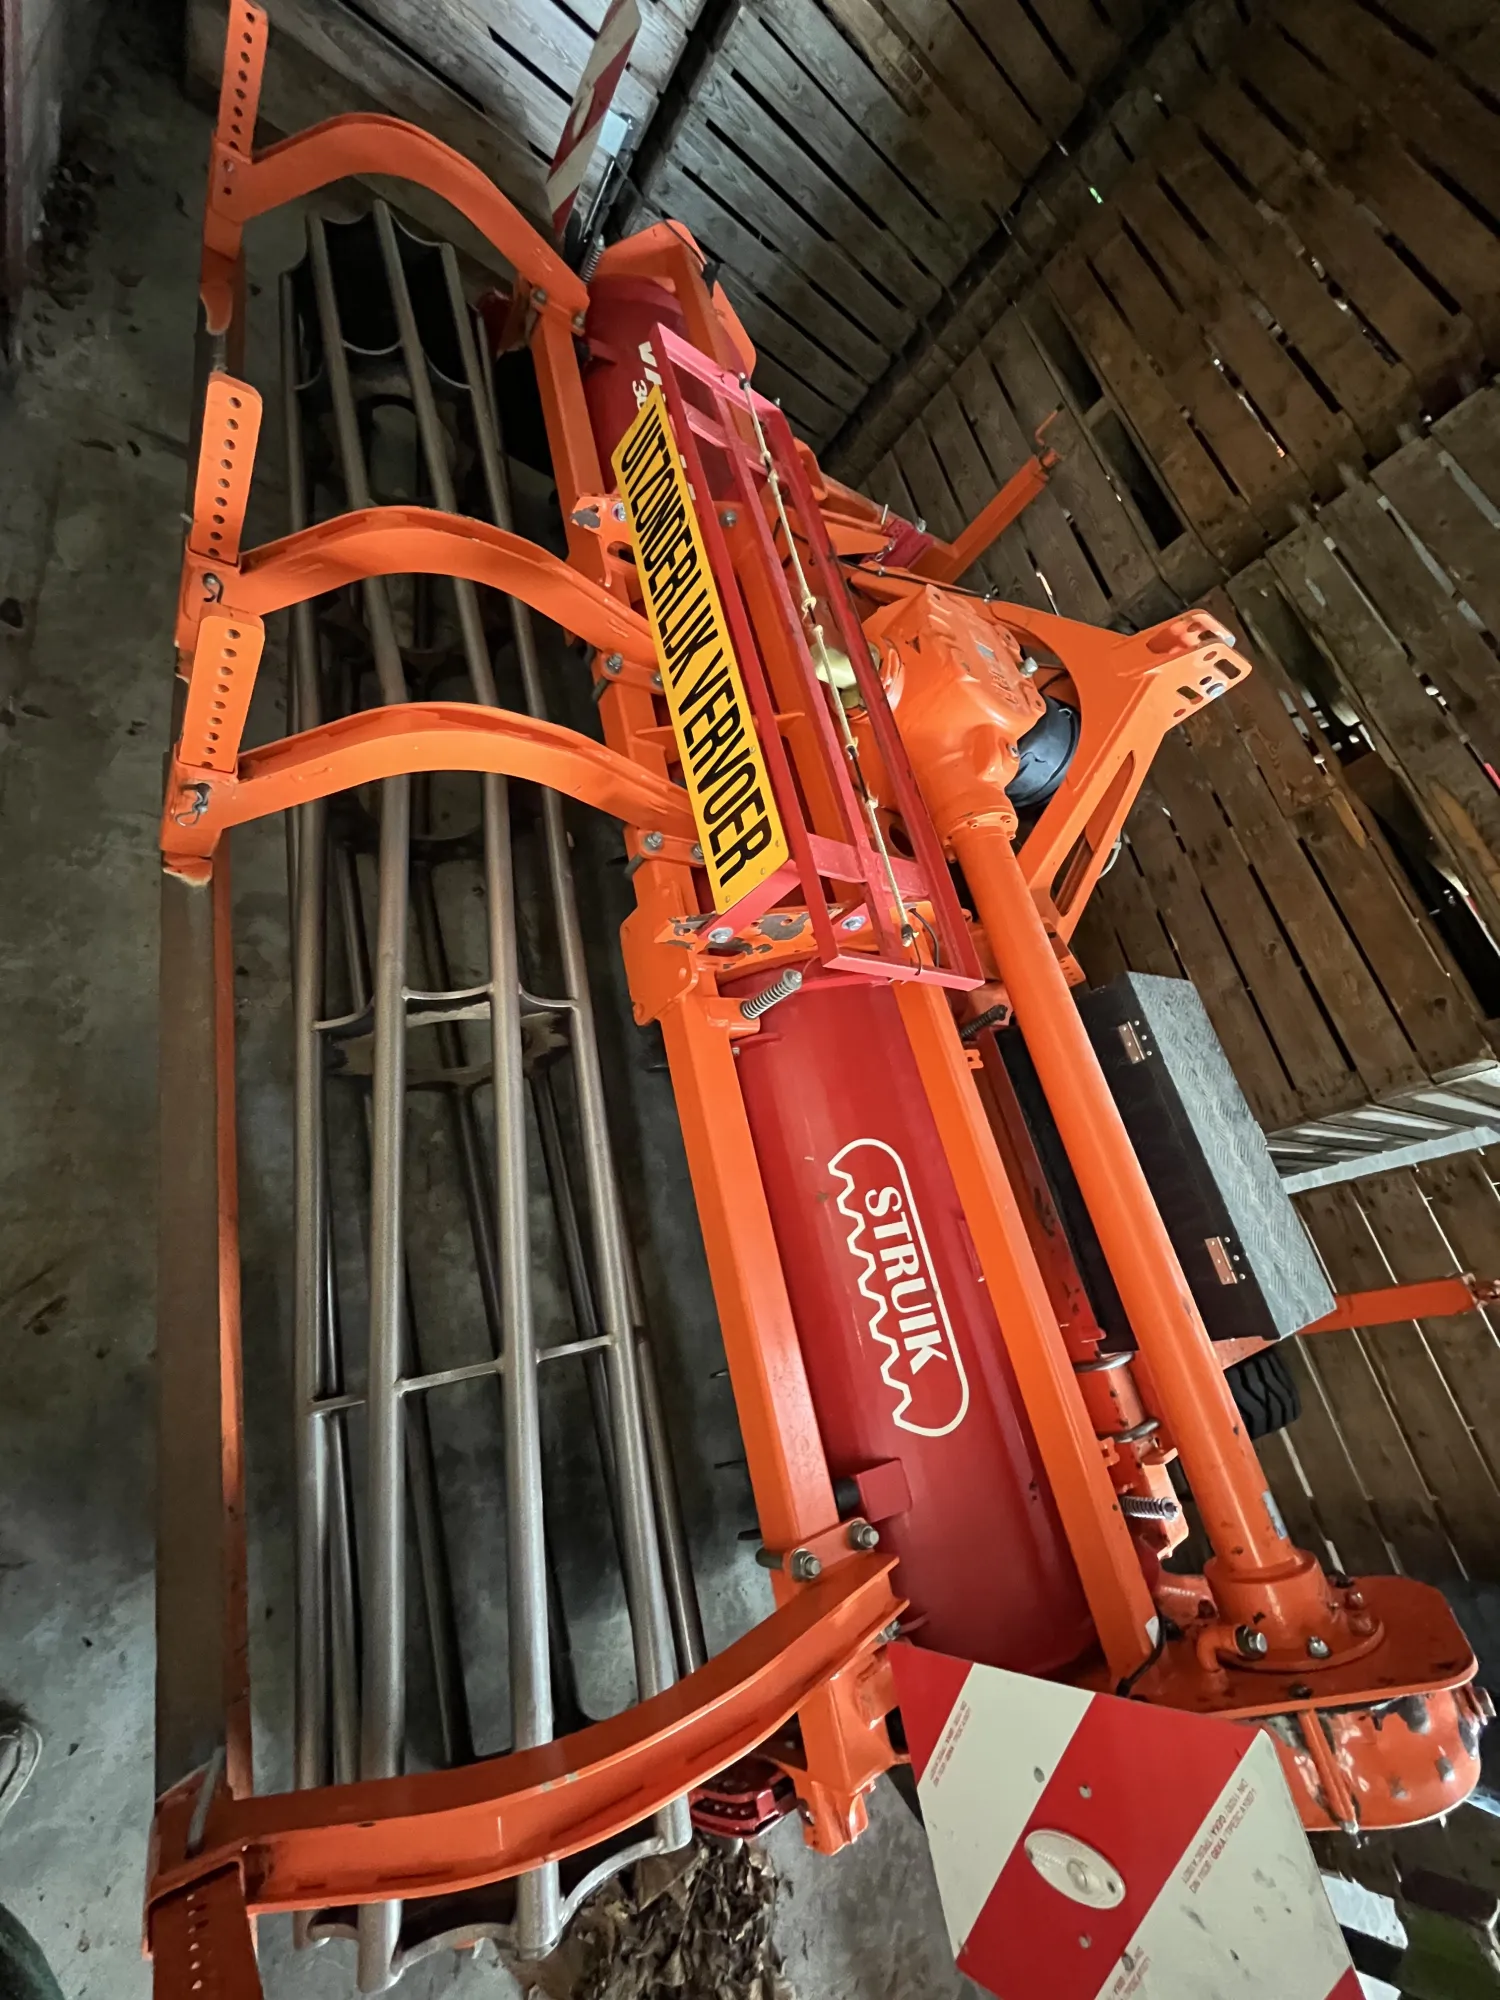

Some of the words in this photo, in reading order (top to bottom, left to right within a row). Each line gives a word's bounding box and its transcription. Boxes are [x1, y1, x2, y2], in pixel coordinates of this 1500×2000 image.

[621, 403, 719, 690] UITZONDERLIJK
[678, 647, 772, 888] VERVOER
[865, 1186, 948, 1375] STRUIK
